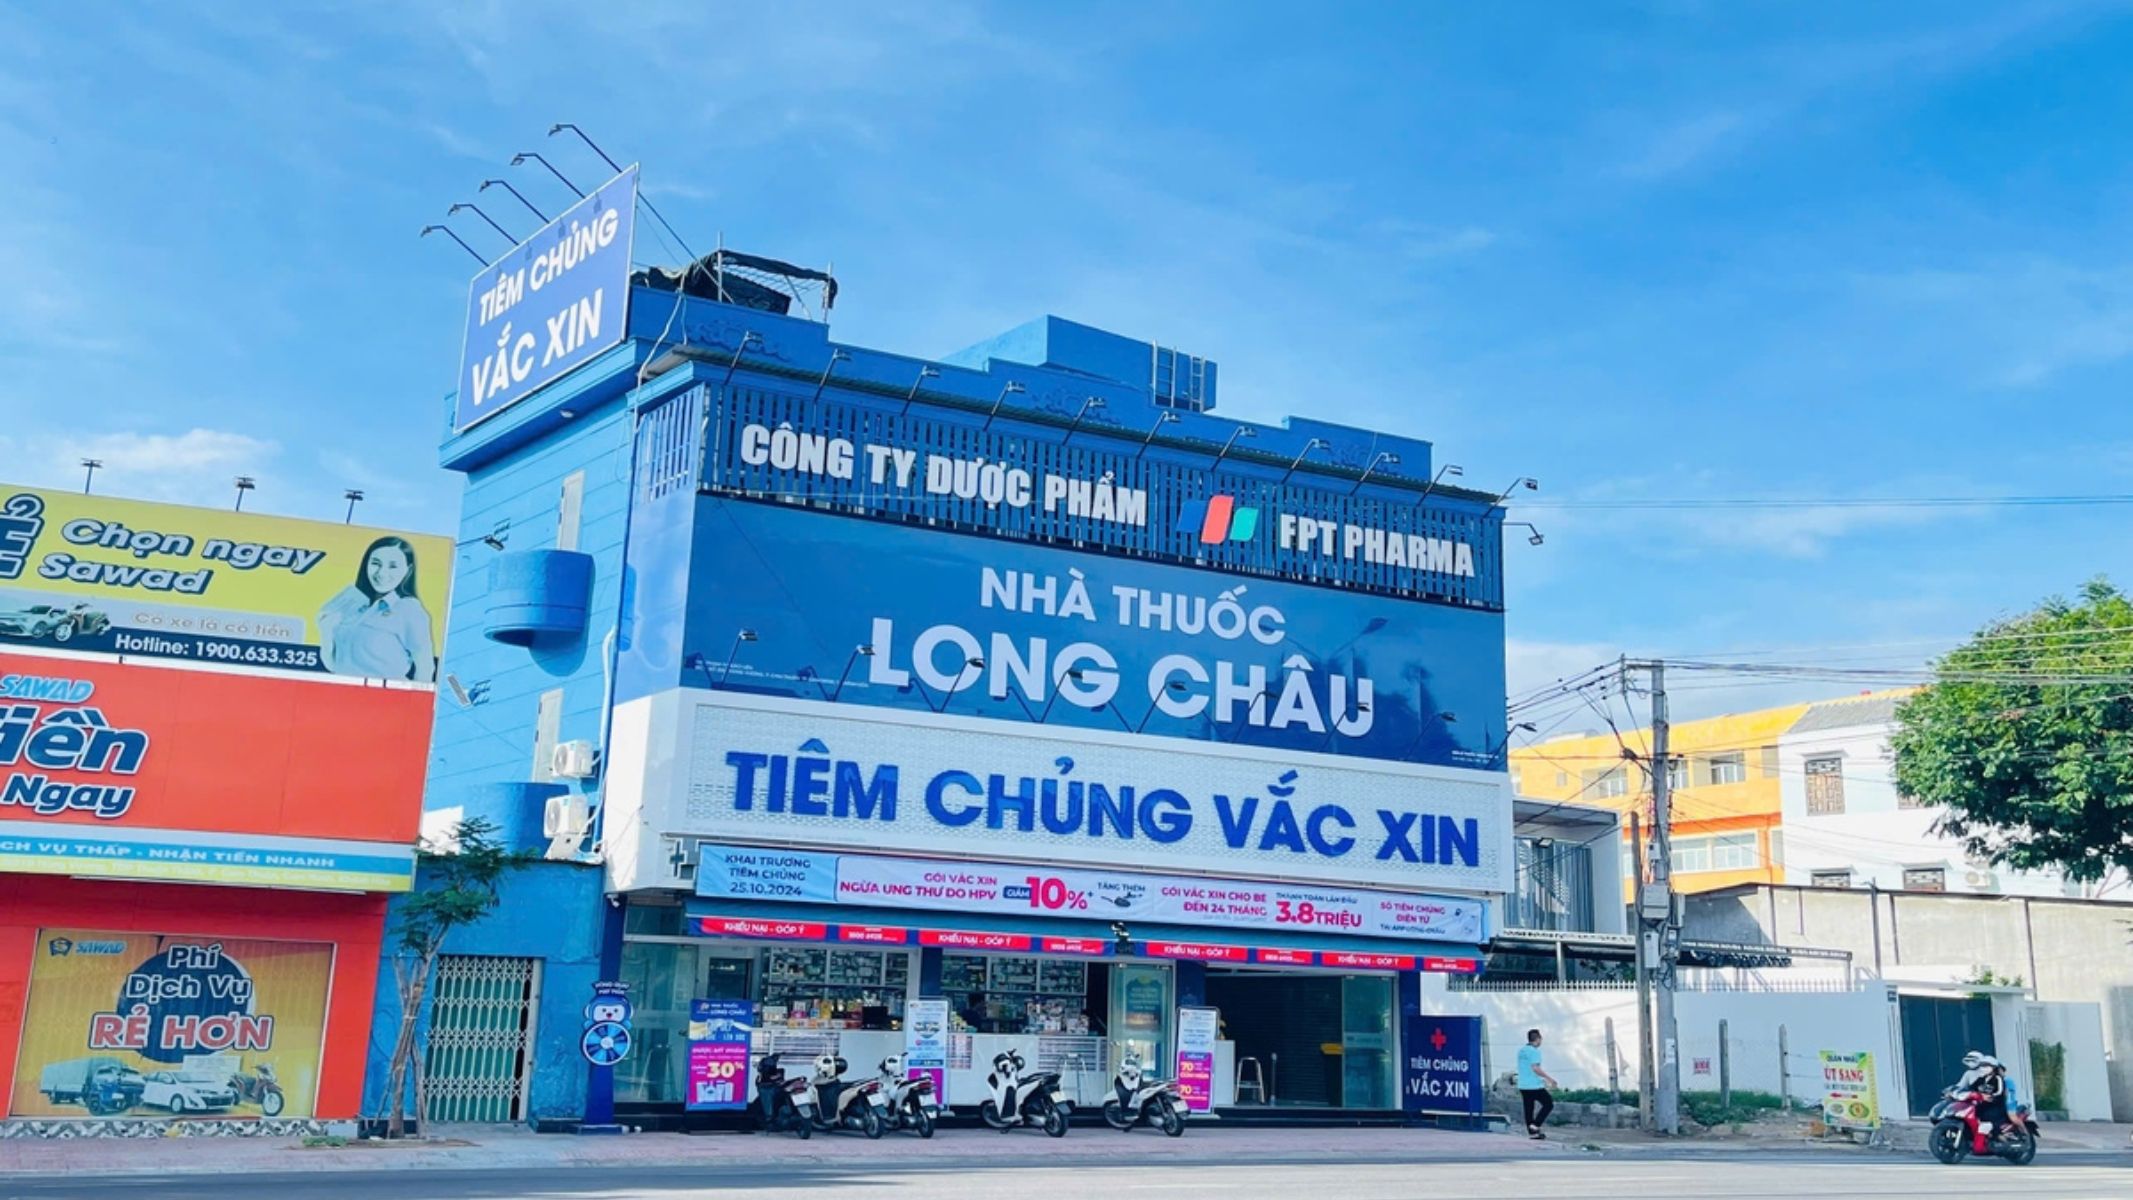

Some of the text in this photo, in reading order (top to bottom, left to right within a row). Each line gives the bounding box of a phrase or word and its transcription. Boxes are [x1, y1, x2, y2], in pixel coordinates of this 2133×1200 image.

[479, 207, 618, 327] TIÊM CHỦNG
[472, 288, 603, 407] VẮC XIN
[740, 421, 1147, 527] CÔNG TY DƯỢC PHẨM
[62, 518, 326, 575] Chọn ngay
[1280, 513, 1475, 578] FPT PHARMA
[38, 552, 213, 594] Sawad
[981, 566, 1287, 645] NHÀ THUỐC
[170, 616, 193, 628] xe
[115, 633, 318, 667] Hotline: 1900.633.325
[0, 674, 94, 702] SAWAD
[868, 616, 1375, 738] LONG CHÂU
[0, 773, 136, 817] Ngay
[725, 737, 1480, 867] TIÊM CHỦNG VẮC XIN
[38, 842, 67, 855] VỤ
[75, 842, 131, 856] THẤP
[150, 848, 206, 863] NHẬN
[265, 855, 335, 867] NHANH
[724, 853, 757, 865] KHAI
[729, 866, 759, 879] TIÊM
[976, 874, 997, 885] XIN
[730, 882, 803, 896] 25.10.2024
[840, 879, 996, 900] NGỪA UNG THƯ DO HPV
[1208, 890, 1226, 900] XIN
[1228, 892, 1251, 903] CHO
[1211, 903, 1225, 913] 24
[1275, 901, 1362, 930] 3.8 TRIỆU
[167, 941, 224, 970] Phí
[126, 972, 253, 1004] Dịch Vụ
[88, 1003, 275, 1051] RẺ HƠN
[1410, 1055, 1469, 1071] TIÊM CHỦNG
[1411, 1072, 1470, 1098] VẮC XIN
